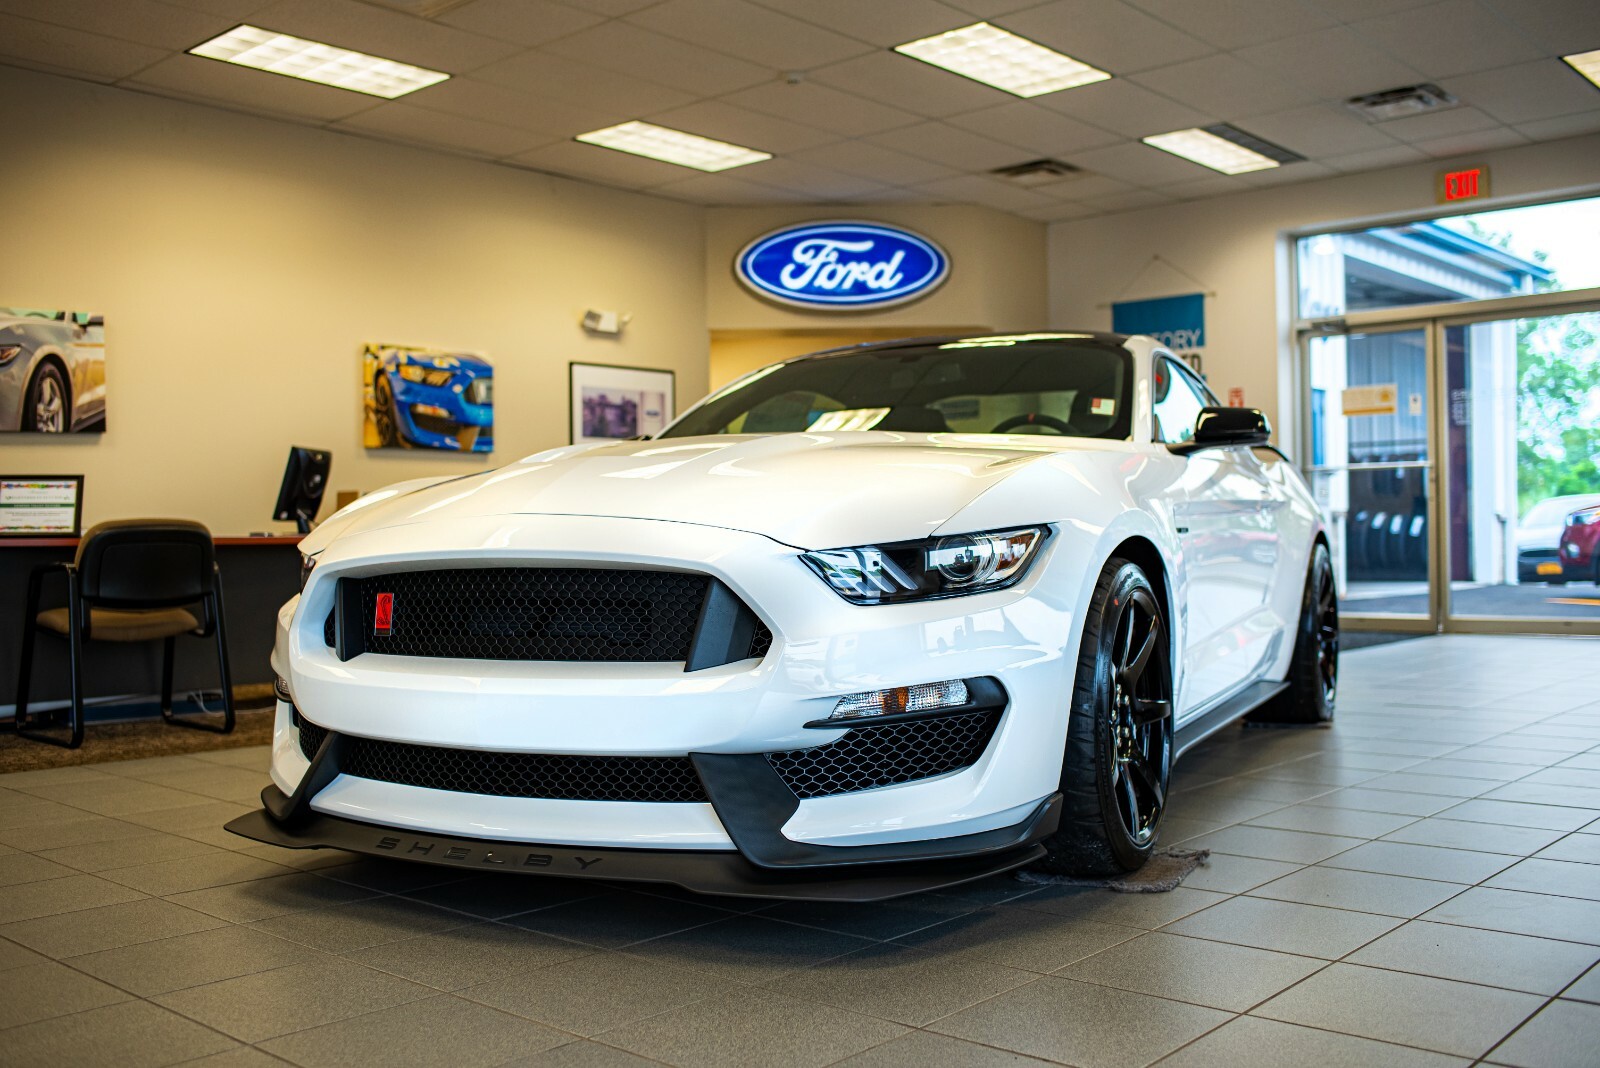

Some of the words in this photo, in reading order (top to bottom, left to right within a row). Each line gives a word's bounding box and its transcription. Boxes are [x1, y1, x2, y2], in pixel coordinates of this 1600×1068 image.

[1445, 168, 1480, 200] EXIT
[780, 238, 906, 290] Ford
[375, 836, 603, 870] SHELBY
